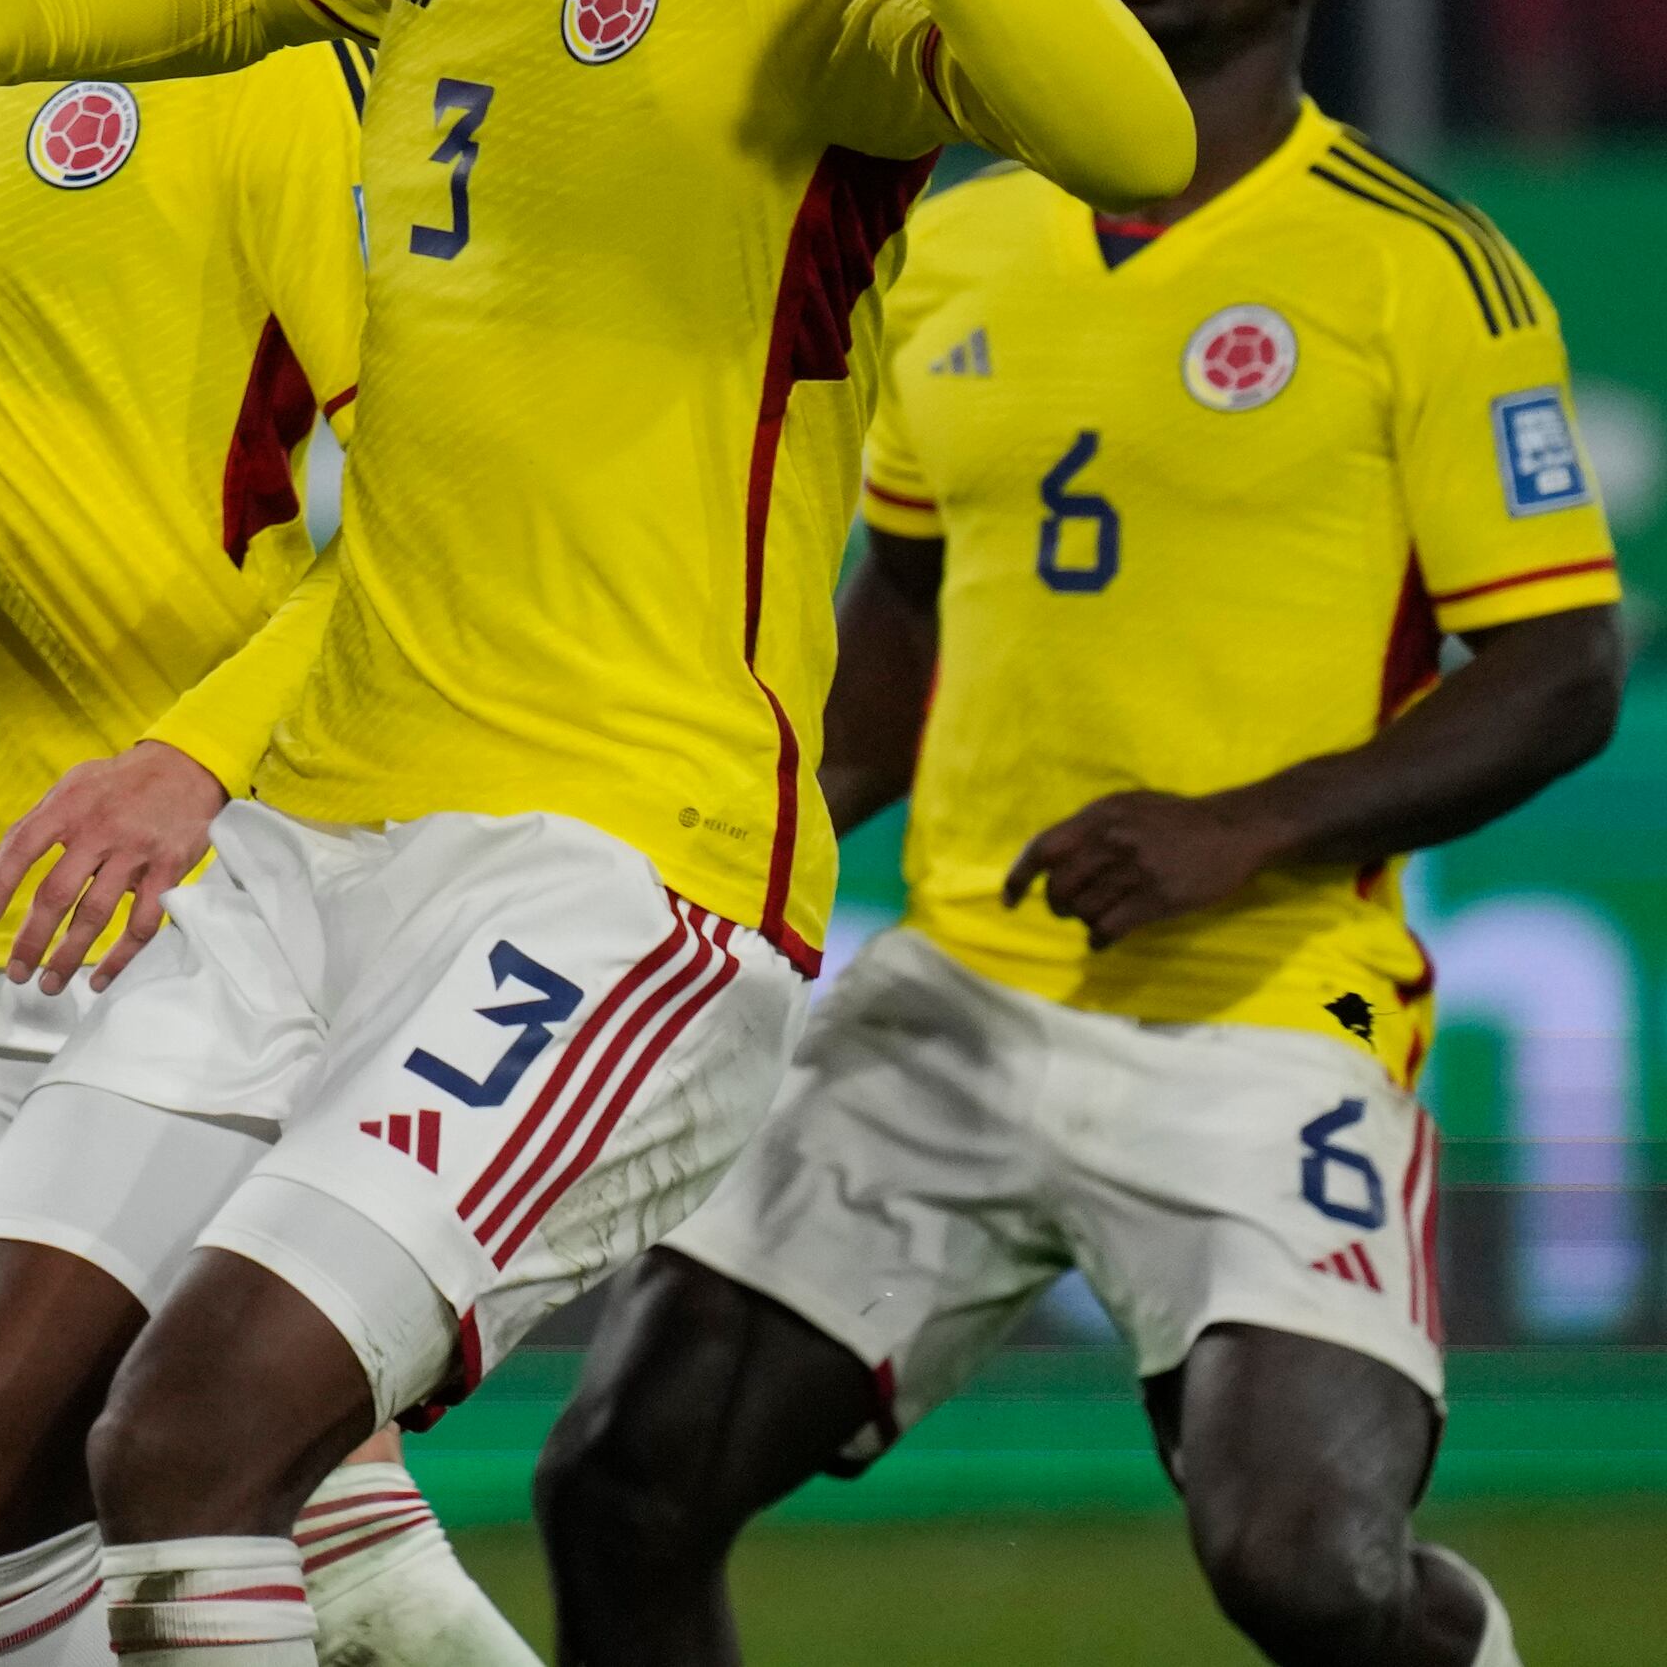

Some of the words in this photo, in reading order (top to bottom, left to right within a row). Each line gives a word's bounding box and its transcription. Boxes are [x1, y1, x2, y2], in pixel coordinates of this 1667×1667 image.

[410, 78, 495, 260] 3
[1036, 431, 1121, 594] 6
[404, 939, 585, 1108] 3
[1299, 1097, 1388, 1231] 6
